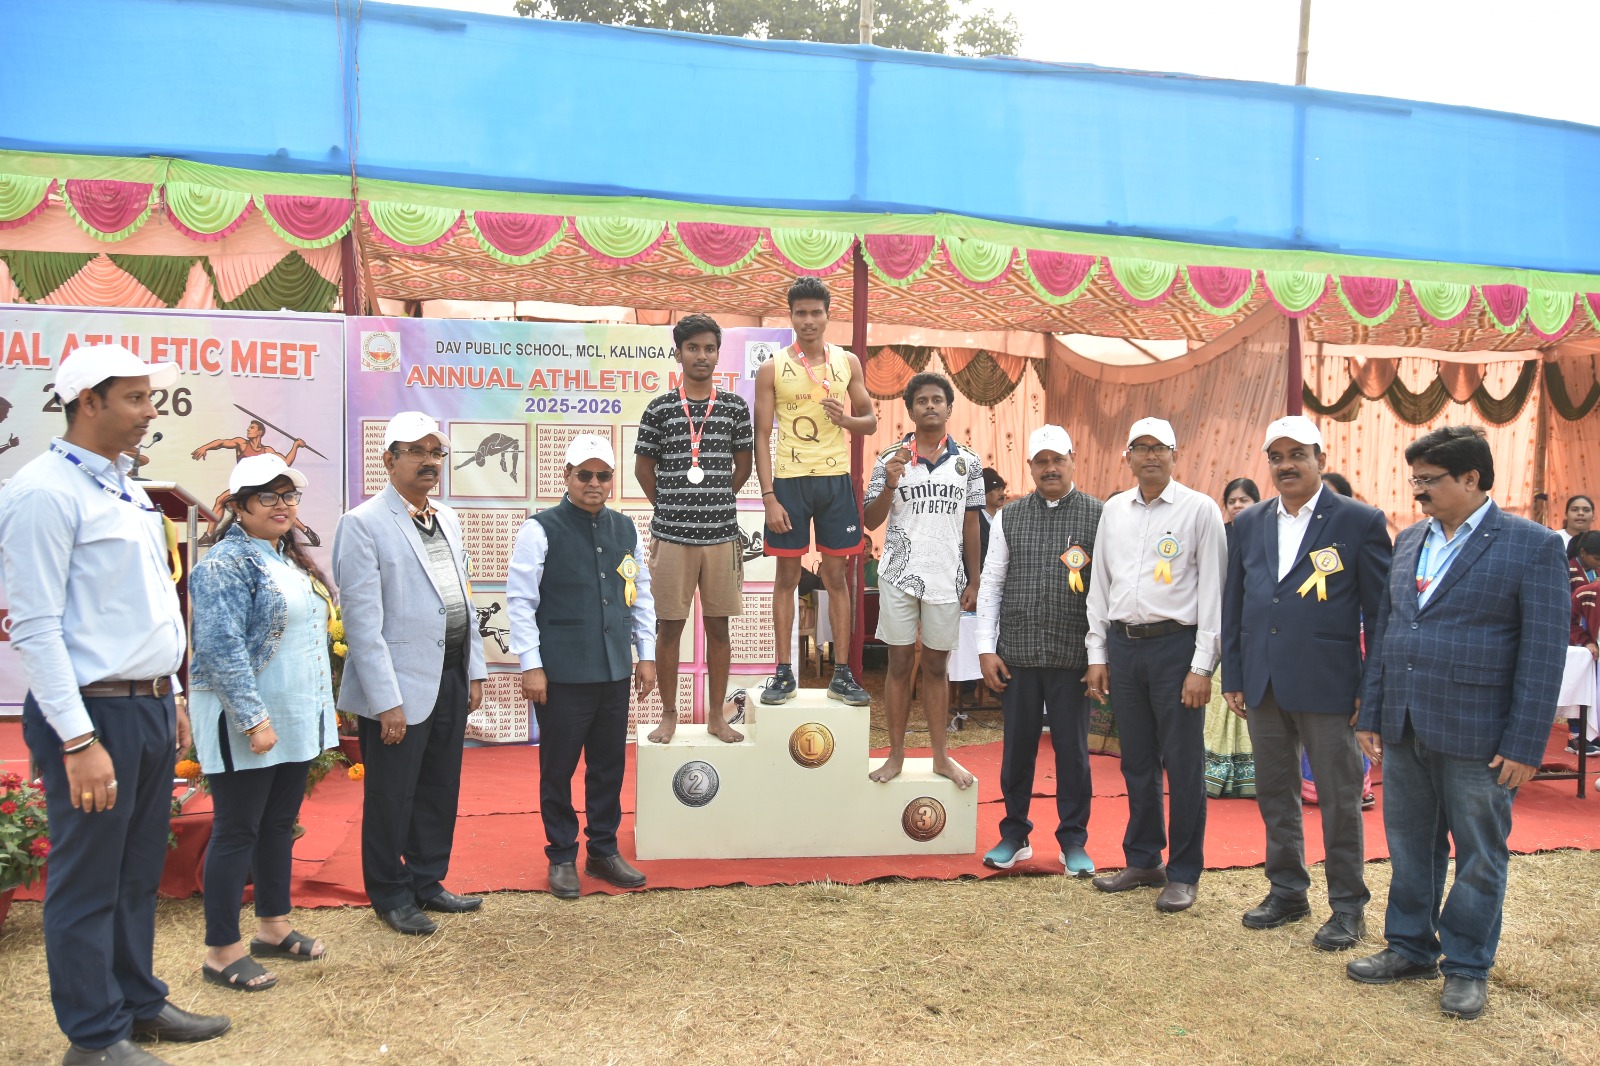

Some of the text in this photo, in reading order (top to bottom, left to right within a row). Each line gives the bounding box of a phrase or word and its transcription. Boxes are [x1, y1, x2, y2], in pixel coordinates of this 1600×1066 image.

[231, 340, 318, 376] MEET
[436, 341, 462, 354] DAV
[465, 342, 512, 356] PUBLIC
[516, 342, 572, 359] SCHOOL,
[576, 344, 606, 360] MCL,
[610, 345, 666, 358] KALINGA
[406, 364, 522, 389] ANNUAL
[528, 367, 659, 392] ATHLETIC
[782, 362, 796, 377] A
[524, 397, 622, 414] 2025-2026
[792, 416, 820, 443] Q
[898, 480, 965, 502] Emirates
[912, 500, 958, 514] FLY BETTER
[806, 733, 818, 756] 1
[689, 772, 703, 794] 2
[916, 806, 932, 830] 3
